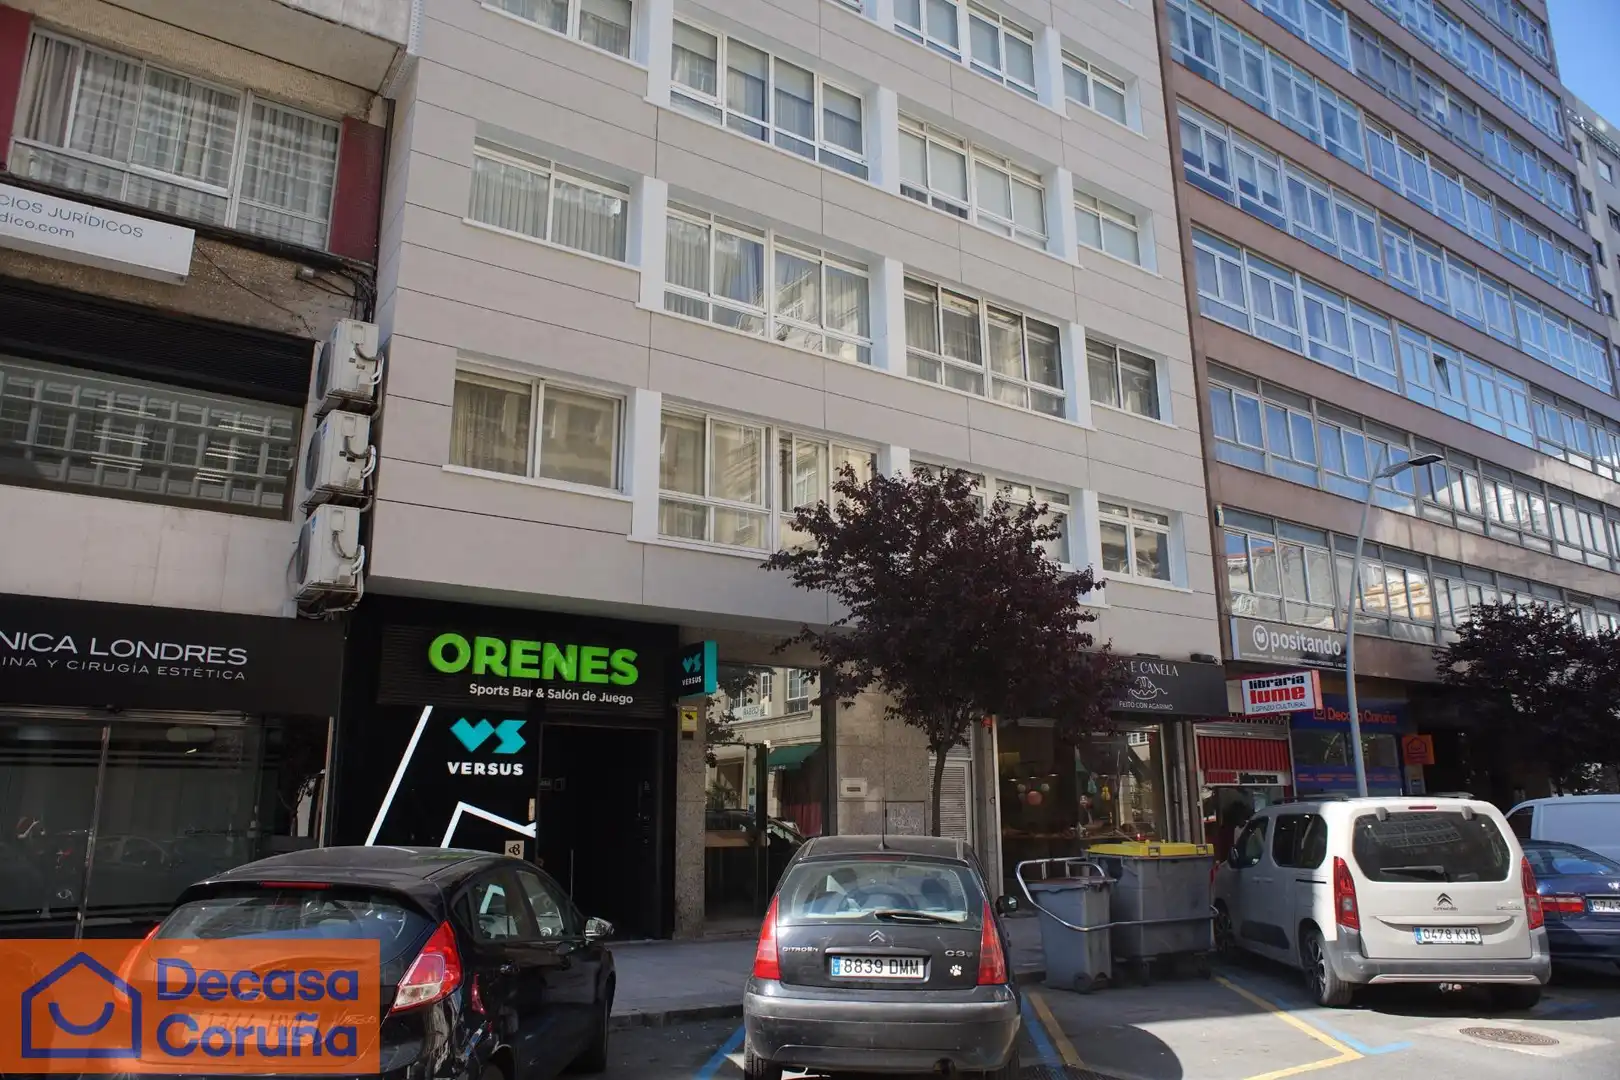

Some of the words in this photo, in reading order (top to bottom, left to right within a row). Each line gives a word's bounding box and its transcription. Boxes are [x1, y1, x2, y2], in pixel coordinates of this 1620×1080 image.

[48, 207, 144, 238] JURÍDICOS
[0, 630, 78, 654] NICA
[90, 637, 248, 666] LONDRES
[2, 656, 37, 668] INA
[48, 659, 59, 669] Y
[66, 660, 150, 675] CIRUGÍA
[157, 665, 245, 680] ESTÉTICA
[428, 633, 639, 686] ORENES
[1140, 661, 1179, 677] CANELA
[682, 675, 702, 686] VERSUS
[469, 683, 510, 697] Sports
[512, 686, 533, 698] Bar
[536, 687, 545, 699] &
[547, 688, 580, 701] Salón
[582, 690, 597, 702] de
[599, 692, 634, 705] Juego
[1250, 686, 1305, 705] lume
[447, 761, 524, 776] VERSUS
[1423, 928, 1453, 940] 0478
[1455, 929, 1478, 940] KYR
[844, 958, 884, 975] 8839
[889, 959, 919, 975] DMM
